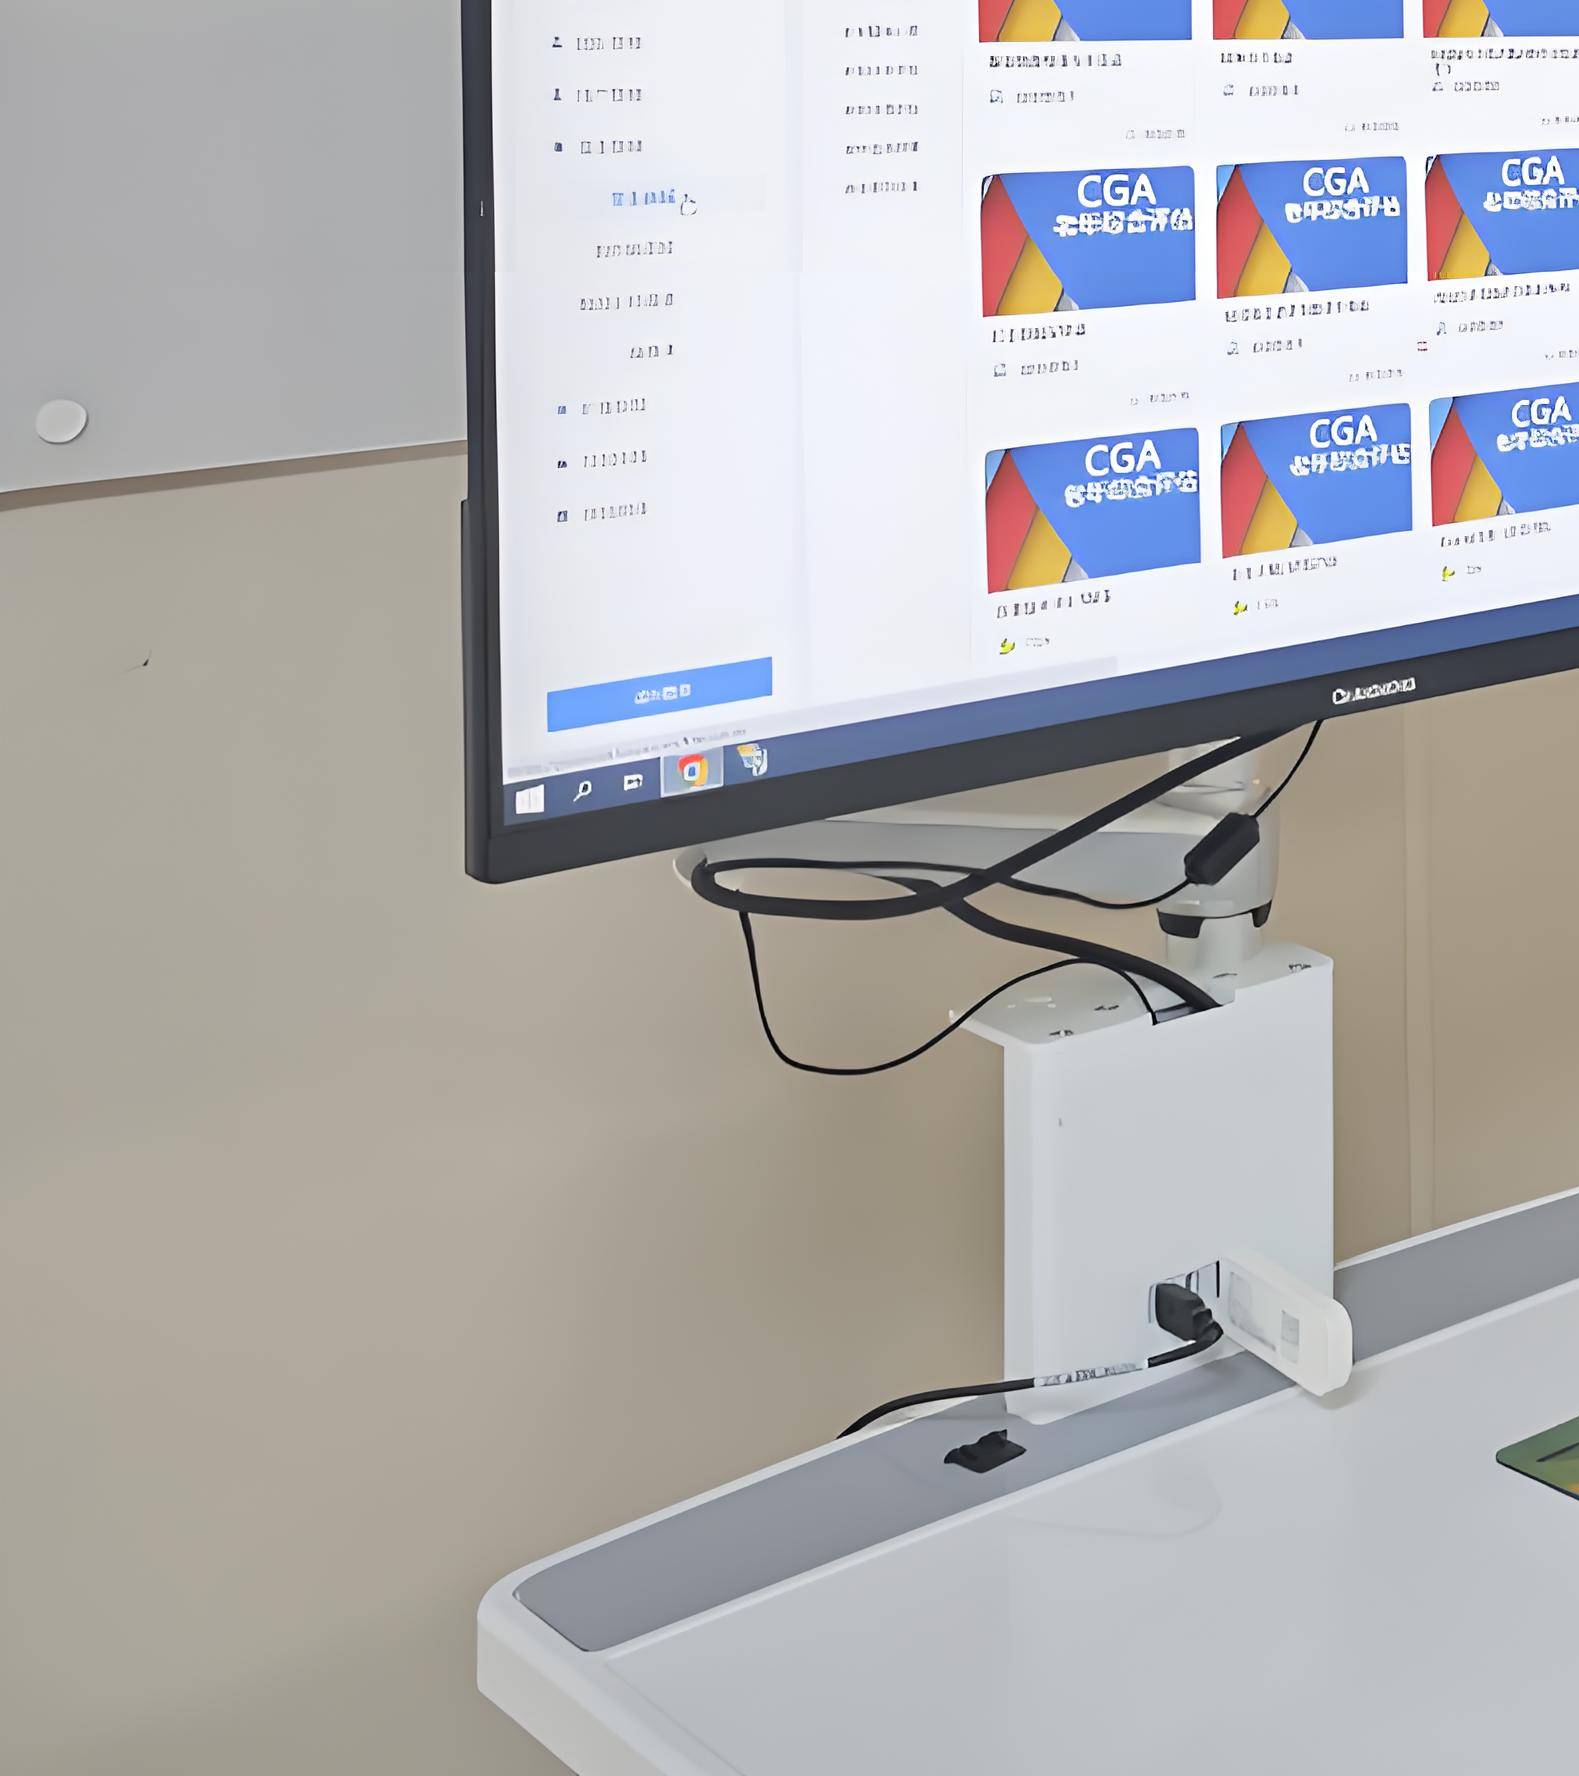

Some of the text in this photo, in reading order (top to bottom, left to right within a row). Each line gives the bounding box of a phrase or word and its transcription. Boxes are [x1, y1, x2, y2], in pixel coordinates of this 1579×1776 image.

[1303, 167, 1369, 197] CGA
[1501, 156, 1564, 186] CGA
[1077, 175, 1155, 207] CGA
[1511, 395, 1572, 428] CGA
[1309, 415, 1378, 449] CGA
[1085, 441, 1161, 476] CGA
